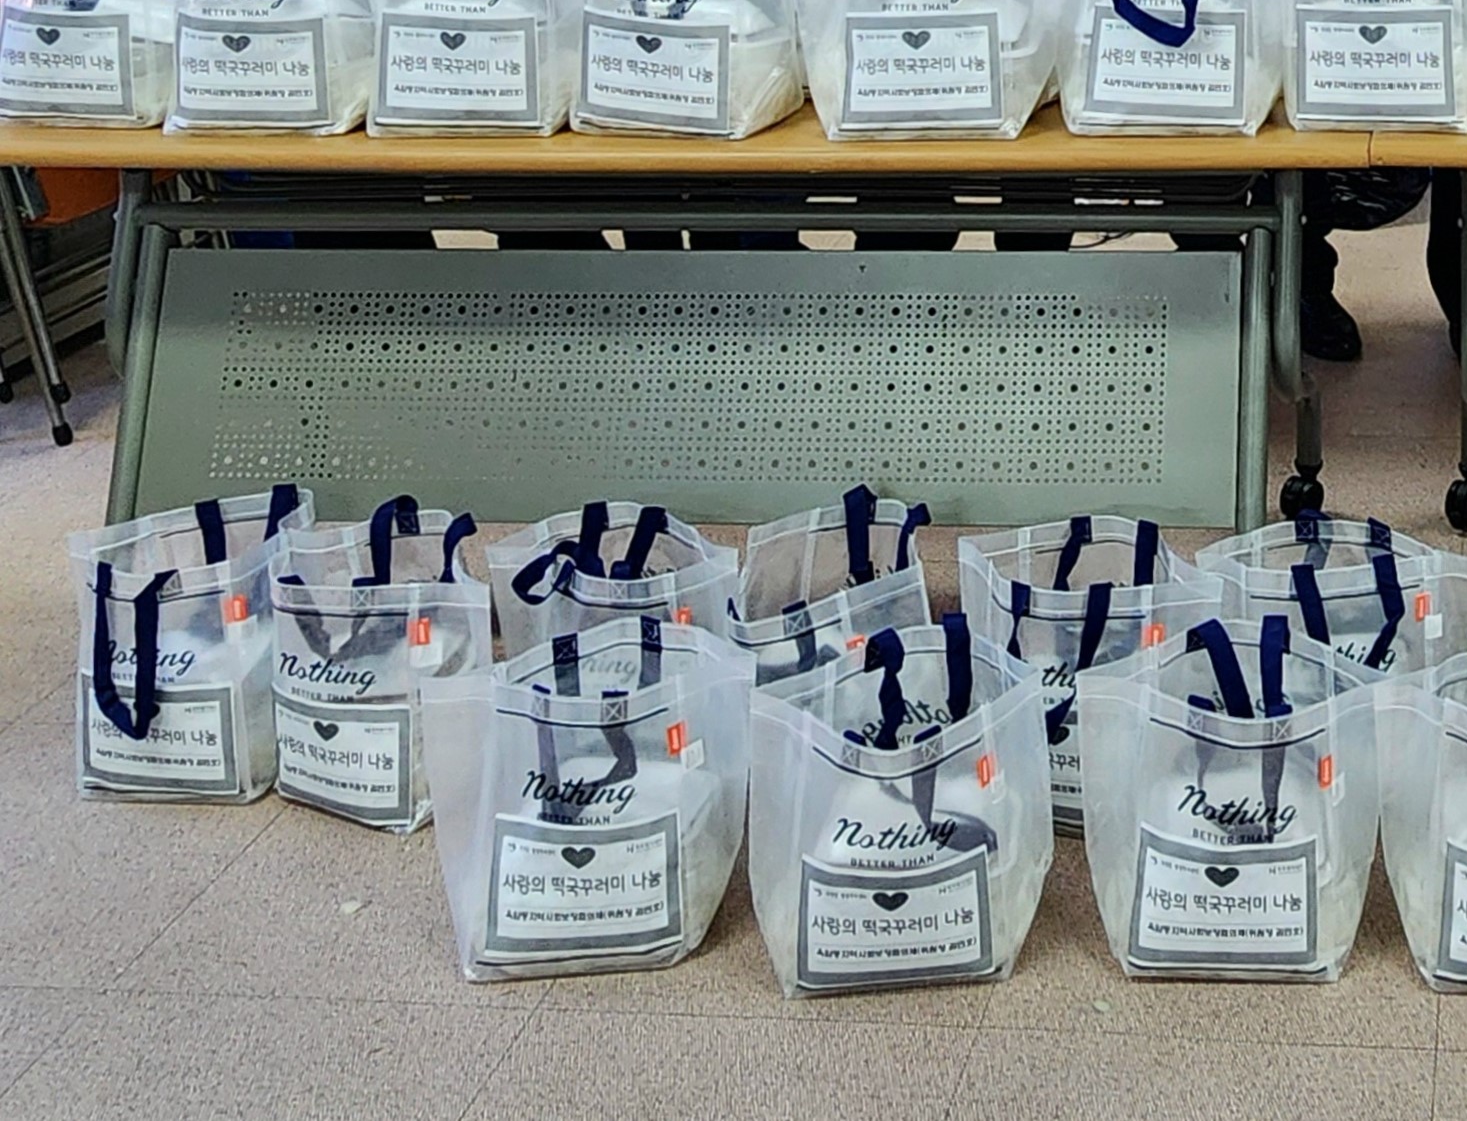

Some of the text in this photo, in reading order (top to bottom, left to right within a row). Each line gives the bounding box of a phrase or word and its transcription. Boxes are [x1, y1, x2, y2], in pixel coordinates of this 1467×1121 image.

[391, 55, 428, 72] 사랑의
[591, 53, 623, 73] 사랑의
[856, 58, 889, 76] 사랑의
[1101, 49, 1134, 66] 사랑의
[1310, 51, 1346, 68] 사랑의
[280, 652, 376, 695] Nothing
[522, 771, 636, 814] Nothing
[1178, 785, 1297, 835] Nothing
[833, 818, 958, 851] Nothing
[1192, 828, 1236, 845] BETTER
[503, 874, 546, 895] 사랑의
[1146, 887, 1187, 911] 사랑의
[812, 915, 856, 935] 사랑의
